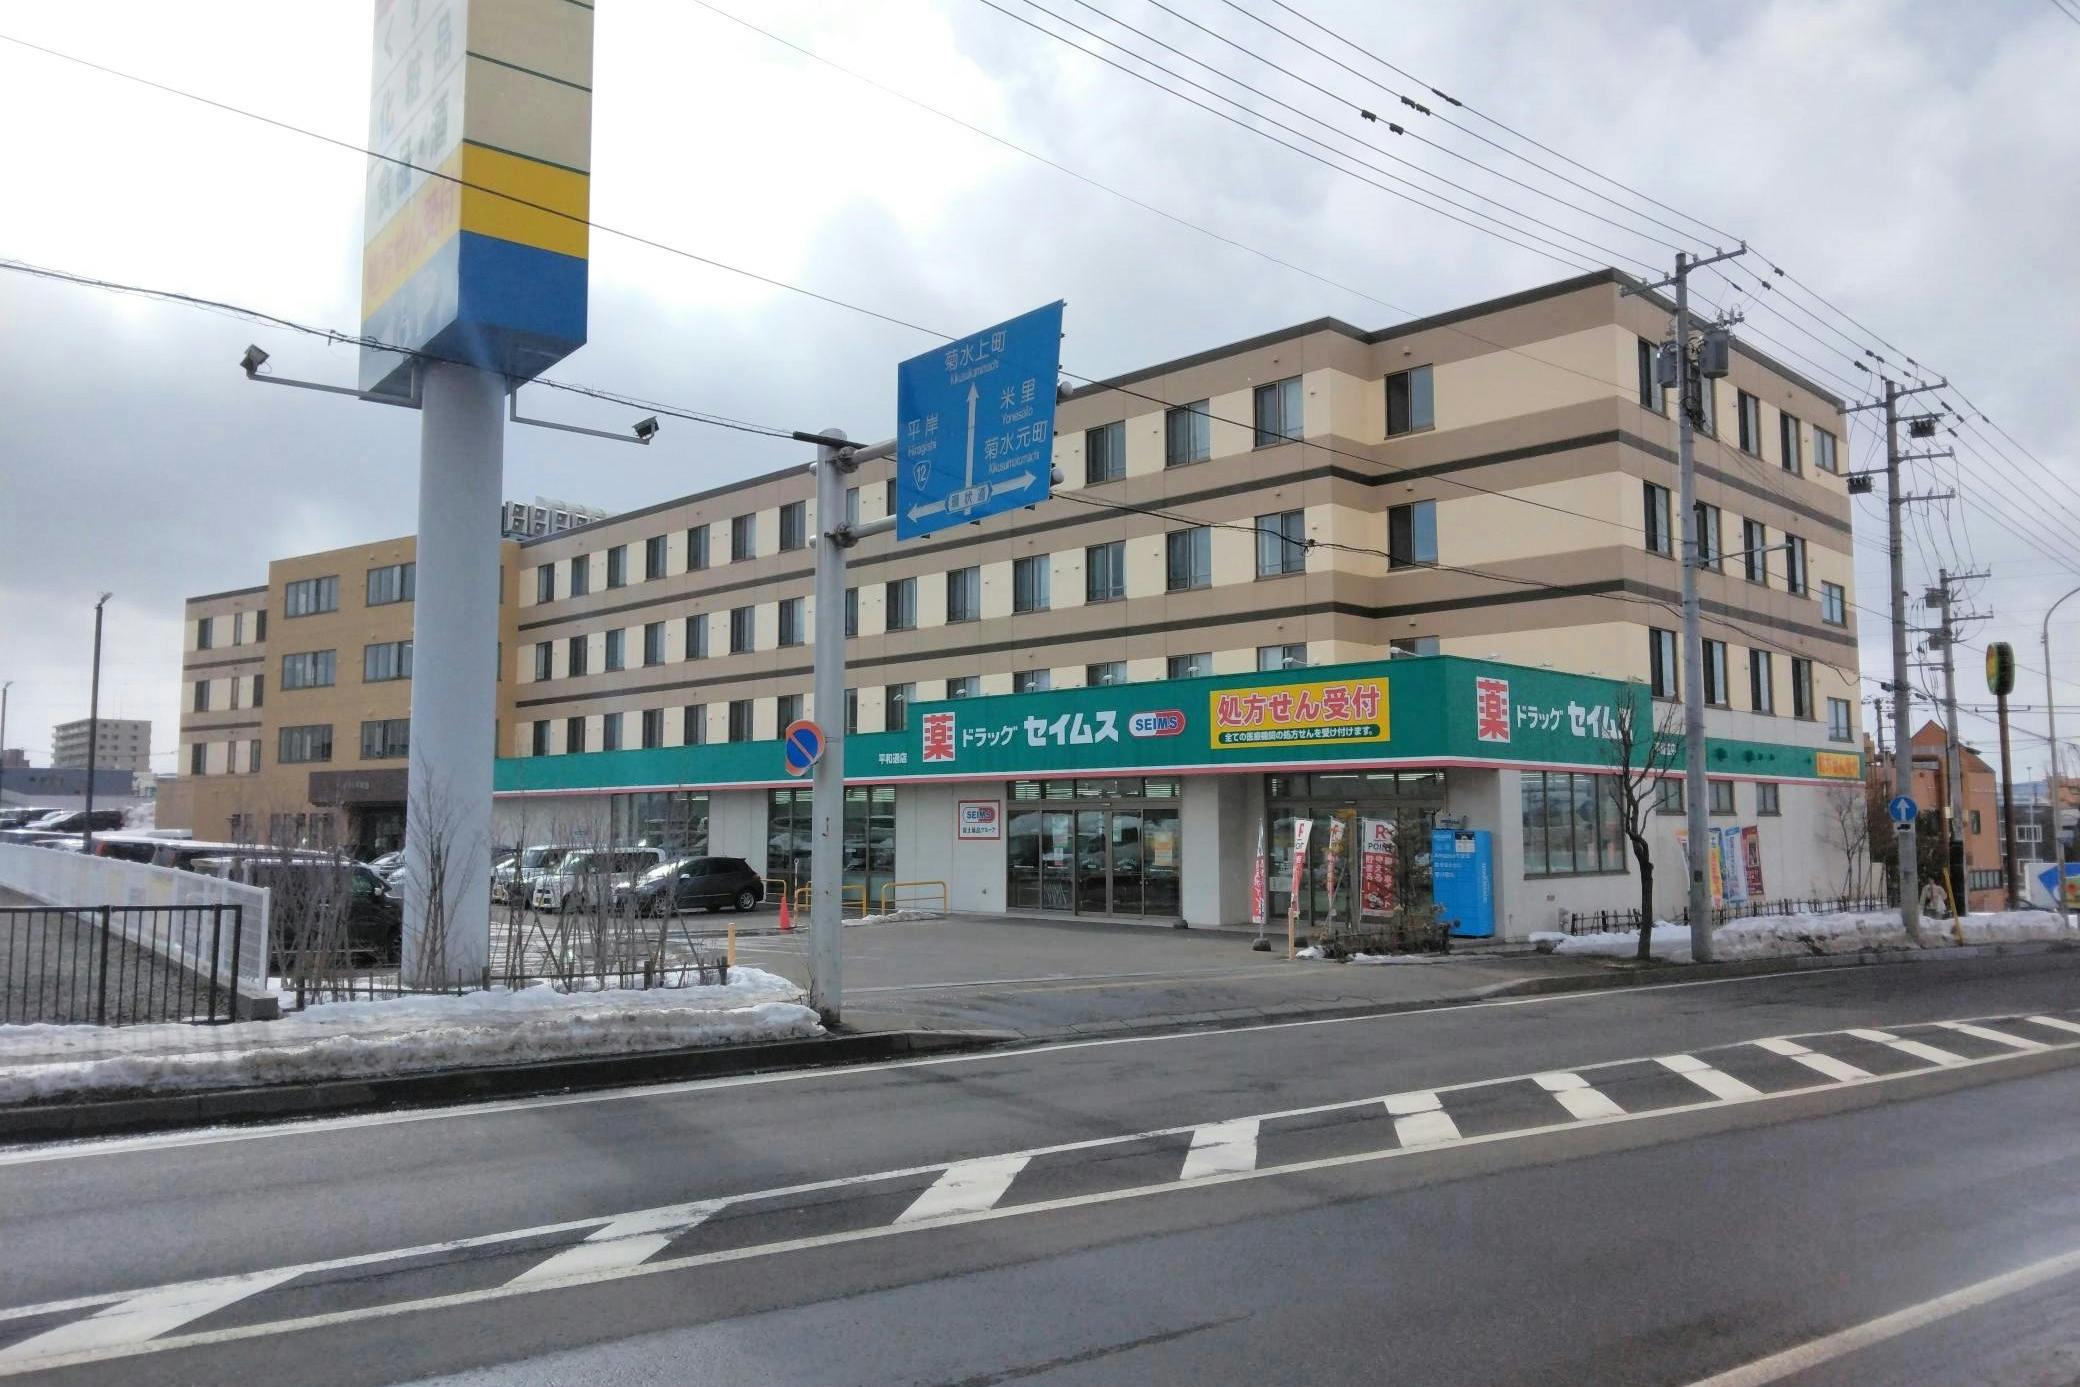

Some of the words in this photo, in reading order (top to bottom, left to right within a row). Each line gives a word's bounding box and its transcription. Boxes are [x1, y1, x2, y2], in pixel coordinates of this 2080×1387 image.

[945, 330, 1006, 371] 菊水上町
[1000, 378, 1036, 409] 米里
[908, 411, 939, 441] 平岸
[985, 420, 1048, 461] 菊水元町
[916, 463, 927, 483] 12
[1135, 716, 1178, 731] SEIMS
[1217, 685, 1381, 726] 処方せん受付
[1478, 678, 1509, 741] 薬
[1517, 704, 1563, 731] ドラッグ
[924, 713, 954, 761] 薬
[962, 725, 1018, 748] ドラッグ
[1024, 710, 1119, 747] セイムス
[966, 810, 992, 820] SEIMS
